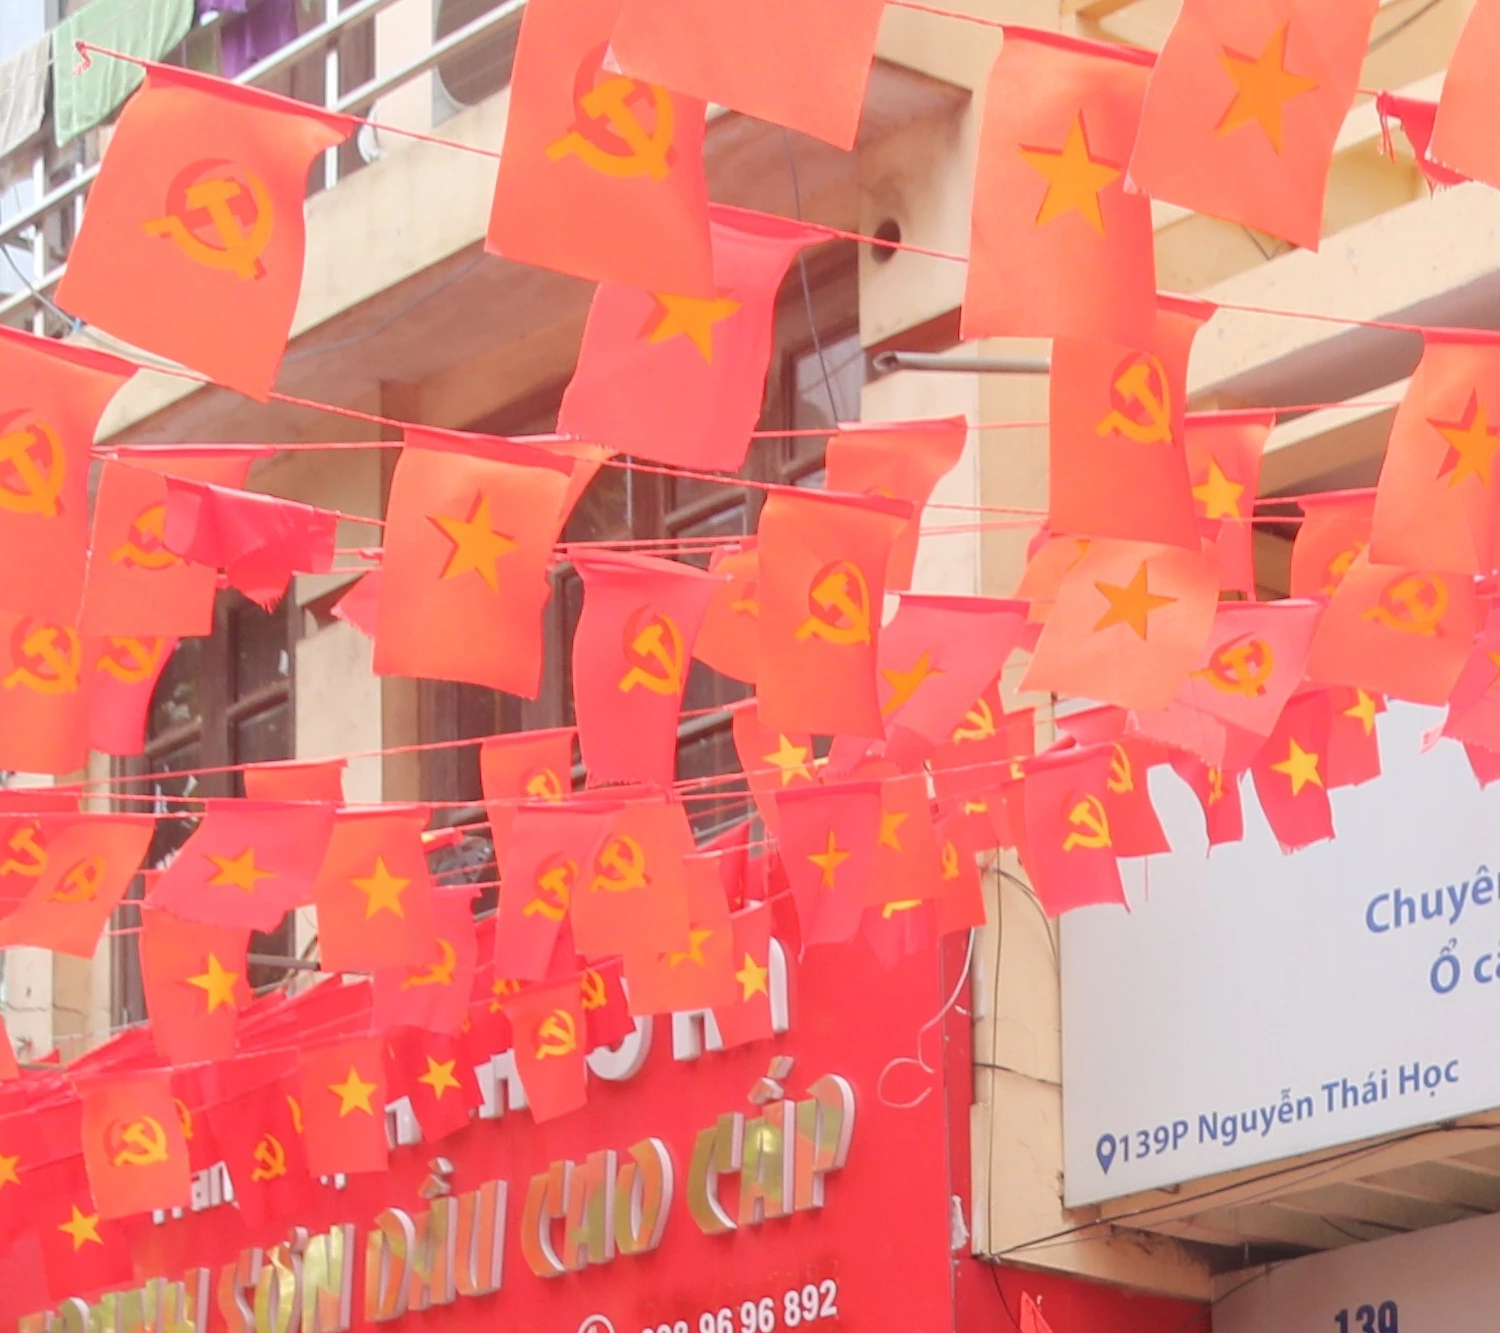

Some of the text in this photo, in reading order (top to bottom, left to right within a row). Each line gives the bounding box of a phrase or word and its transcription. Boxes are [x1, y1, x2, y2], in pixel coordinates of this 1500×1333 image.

[1428, 937, 1462, 995] Ổ
[1117, 1058, 1461, 1164] 139P Nguyễn Thái Học
[364, 1155, 509, 1326] DẦU
[520, 1135, 675, 1279] CAO
[687, 1054, 858, 1238] CẤP
[782, 1277, 839, 1330] 892
